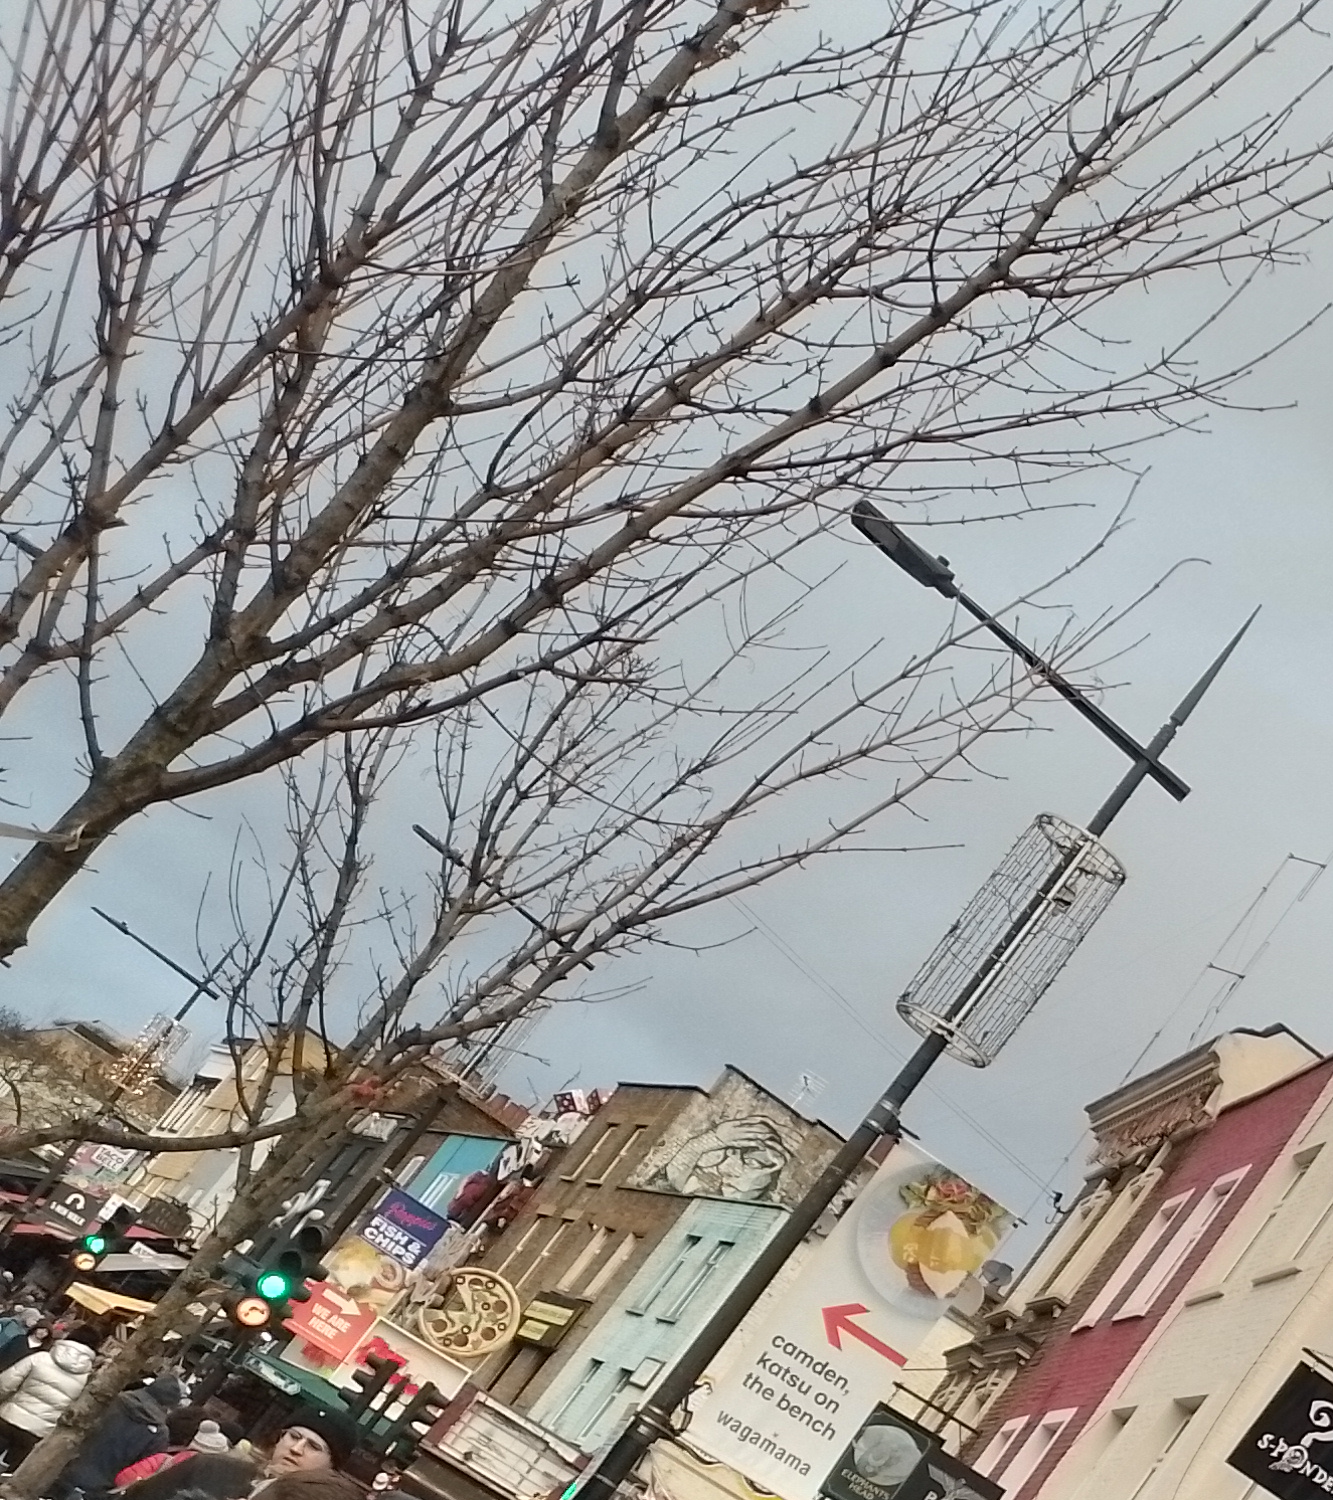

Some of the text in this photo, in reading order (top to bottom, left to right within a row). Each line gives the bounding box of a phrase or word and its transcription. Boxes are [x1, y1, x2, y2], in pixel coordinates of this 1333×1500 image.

[101, 1147, 125, 1164] TACO
[363, 1226, 417, 1265] CHIPS
[370, 1215, 411, 1245] FISH
[308, 1316, 339, 1340] HERE
[310, 1302, 352, 1333] WE ARE
[756, 1350, 840, 1414] katsu on
[771, 1334, 851, 1396] camden,
[742, 1371, 837, 1442] the bench
[716, 1409, 811, 1477] wagamama
